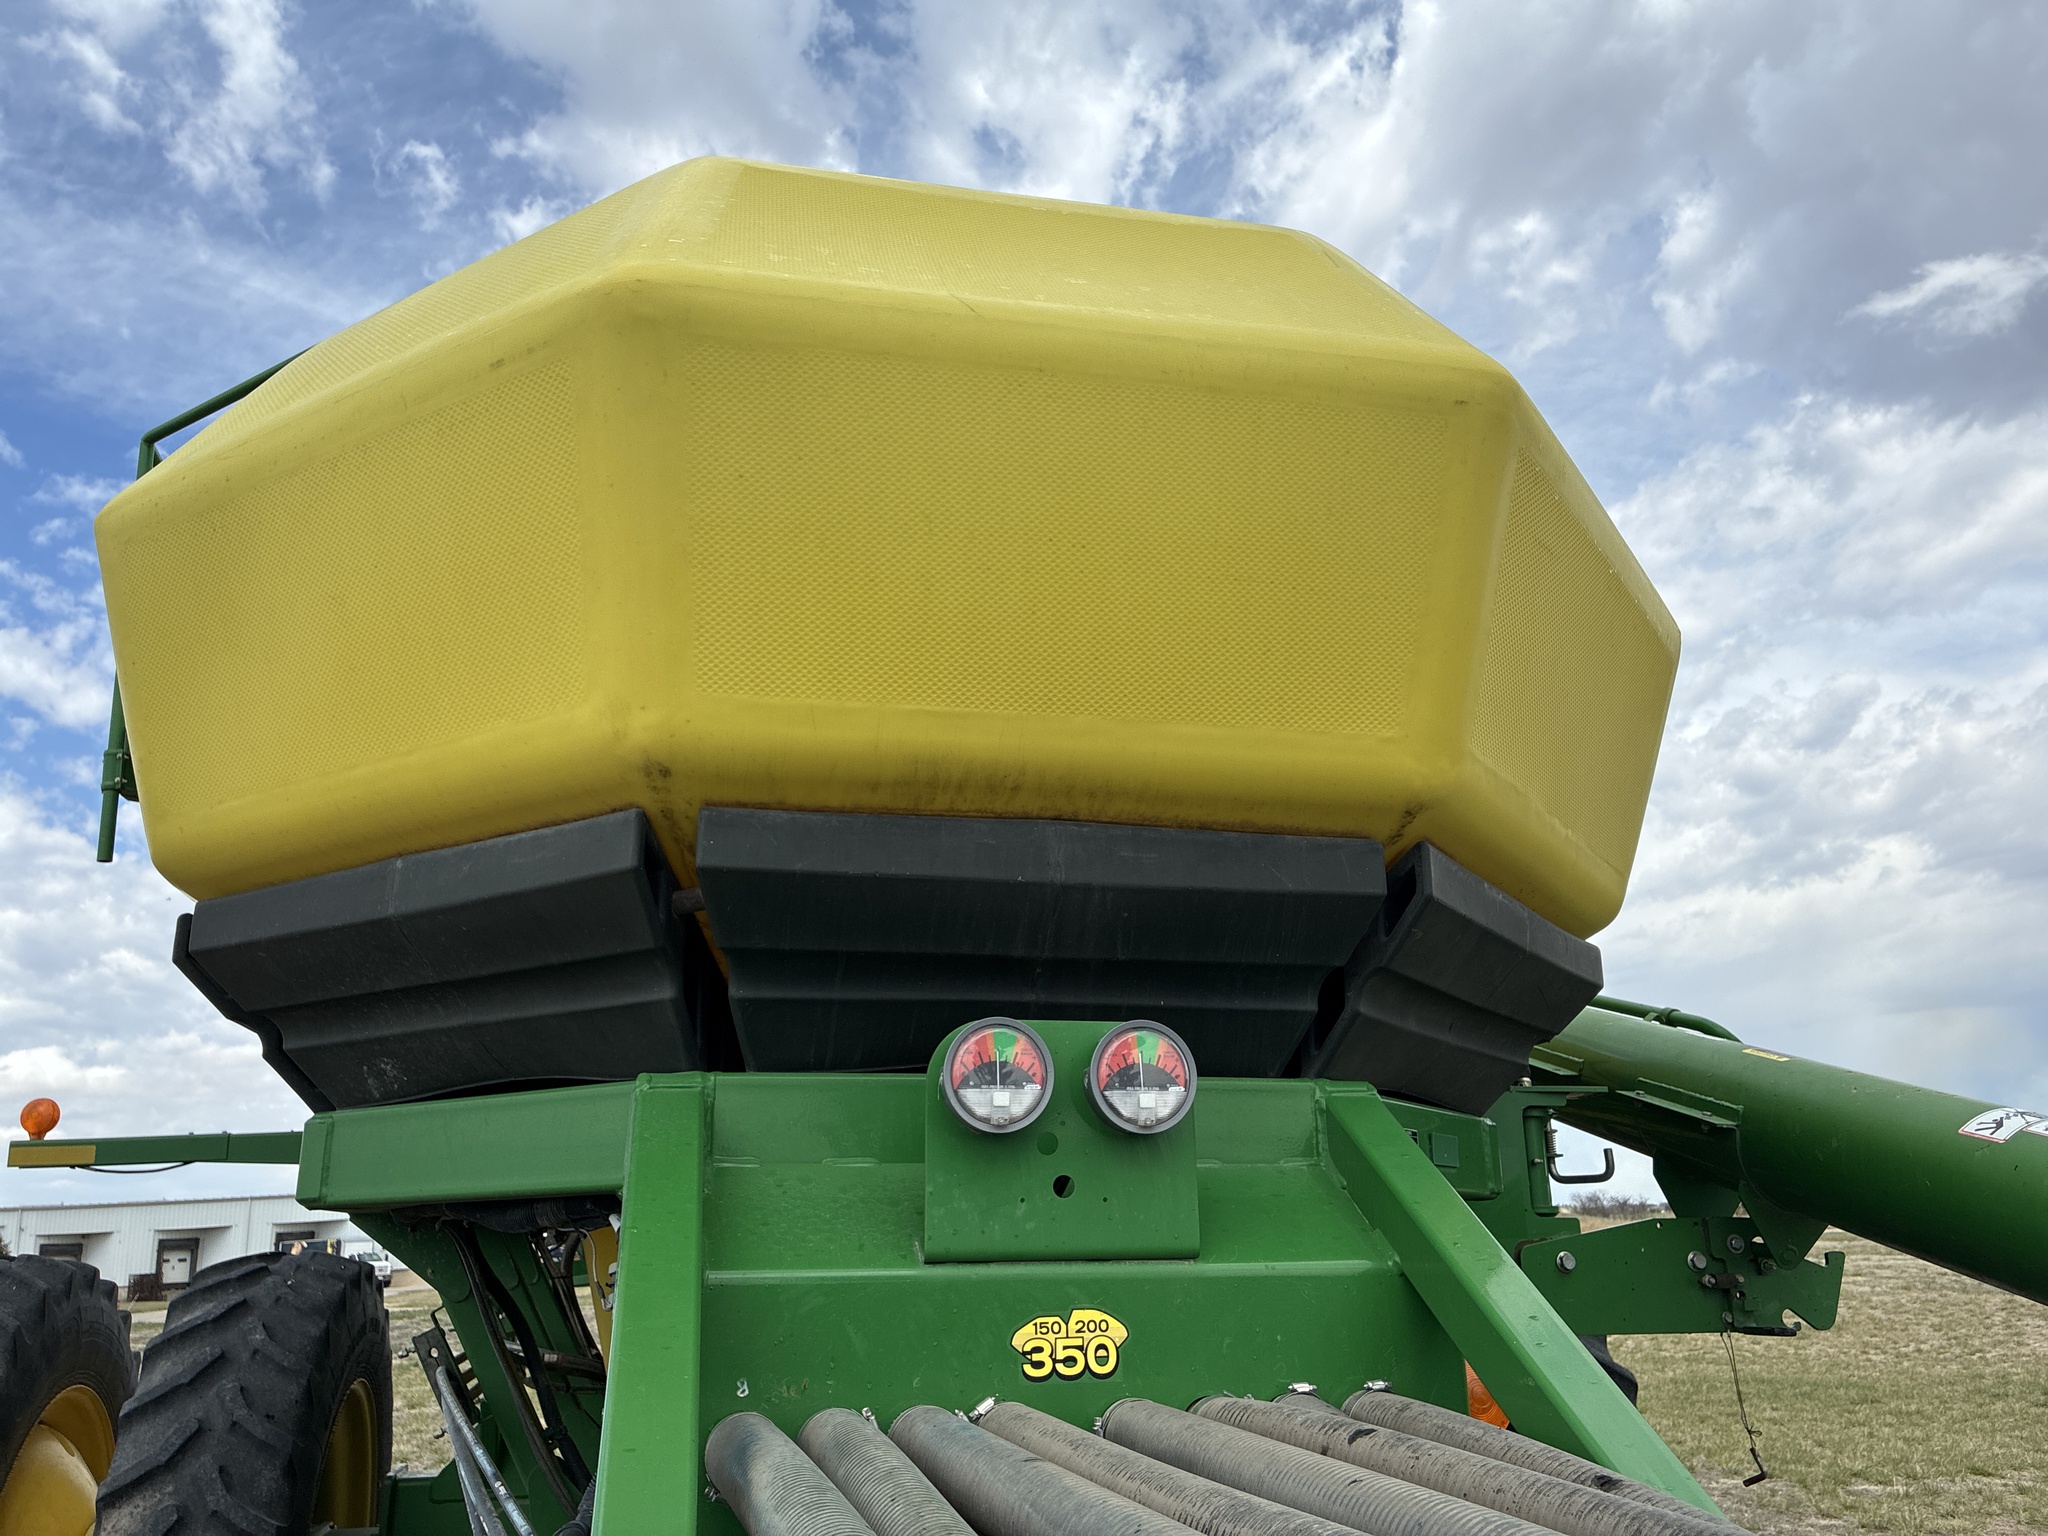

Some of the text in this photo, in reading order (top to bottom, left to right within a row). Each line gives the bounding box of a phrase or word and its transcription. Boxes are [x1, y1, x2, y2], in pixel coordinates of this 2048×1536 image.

[1033, 1319, 1109, 1335] 150 200
[1022, 1335, 1118, 1380] 350
